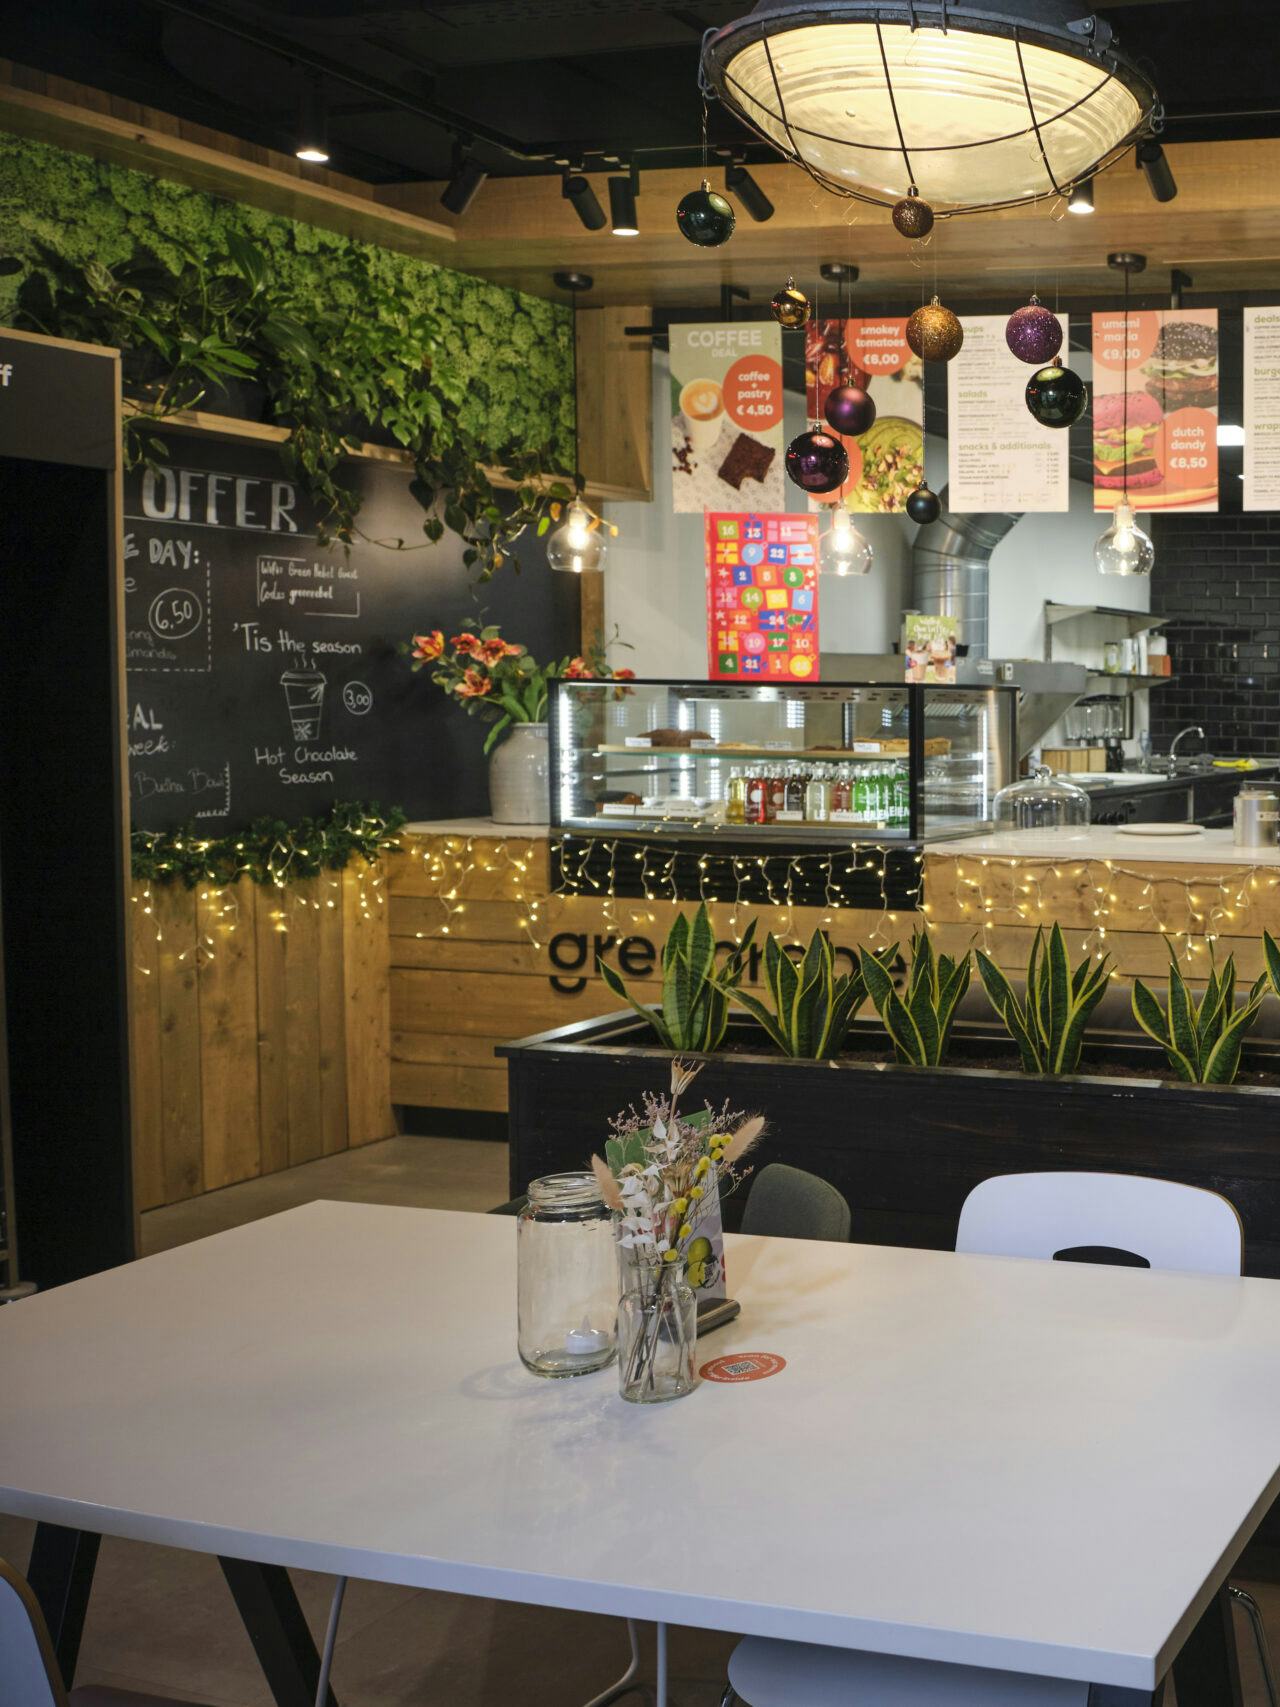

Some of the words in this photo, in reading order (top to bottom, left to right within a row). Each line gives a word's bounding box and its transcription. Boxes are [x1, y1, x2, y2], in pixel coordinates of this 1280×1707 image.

[1102, 318, 1140, 329] umami
[1254, 315, 1280, 323] deals
[860, 325, 900, 337] smokey
[963, 326, 983, 336] oups
[687, 330, 762, 347] COFFEE
[856, 338, 905, 347] tomatoes
[712, 348, 737, 357] DEAL
[738, 371, 770, 382] coffee
[737, 389, 771, 401] pastry
[736, 404, 745, 416] €
[747, 404, 774, 416] 4,50
[1172, 427, 1204, 437] dutch
[959, 443, 989, 451] snacks
[999, 440, 1053, 450] additionals
[1170, 440, 1206, 452] dandy
[1170, 457, 1208, 469] €8,50
[142, 467, 298, 532] OFFER
[149, 538, 199, 569] DAY:
[770, 549, 785, 559] 22
[288, 561, 311, 576] Green
[313, 563, 334, 578] Rebel
[739, 570, 746, 581] 2
[789, 571, 797, 582] 8
[745, 592, 759, 602] 14
[798, 594, 806, 605] 6
[156, 600, 192, 630] 6.50
[769, 615, 785, 626] 24
[278, 629, 306, 652] the
[312, 641, 362, 654] season
[772, 638, 785, 648] 17
[796, 637, 809, 649] 10
[725, 658, 734, 668] 4
[775, 659, 782, 670] 1
[345, 689, 369, 709] 3,00
[127, 703, 163, 731] AL
[255, 747, 286, 765] Hot
[295, 746, 358, 764] Chocolate
[279, 768, 334, 784] Season
